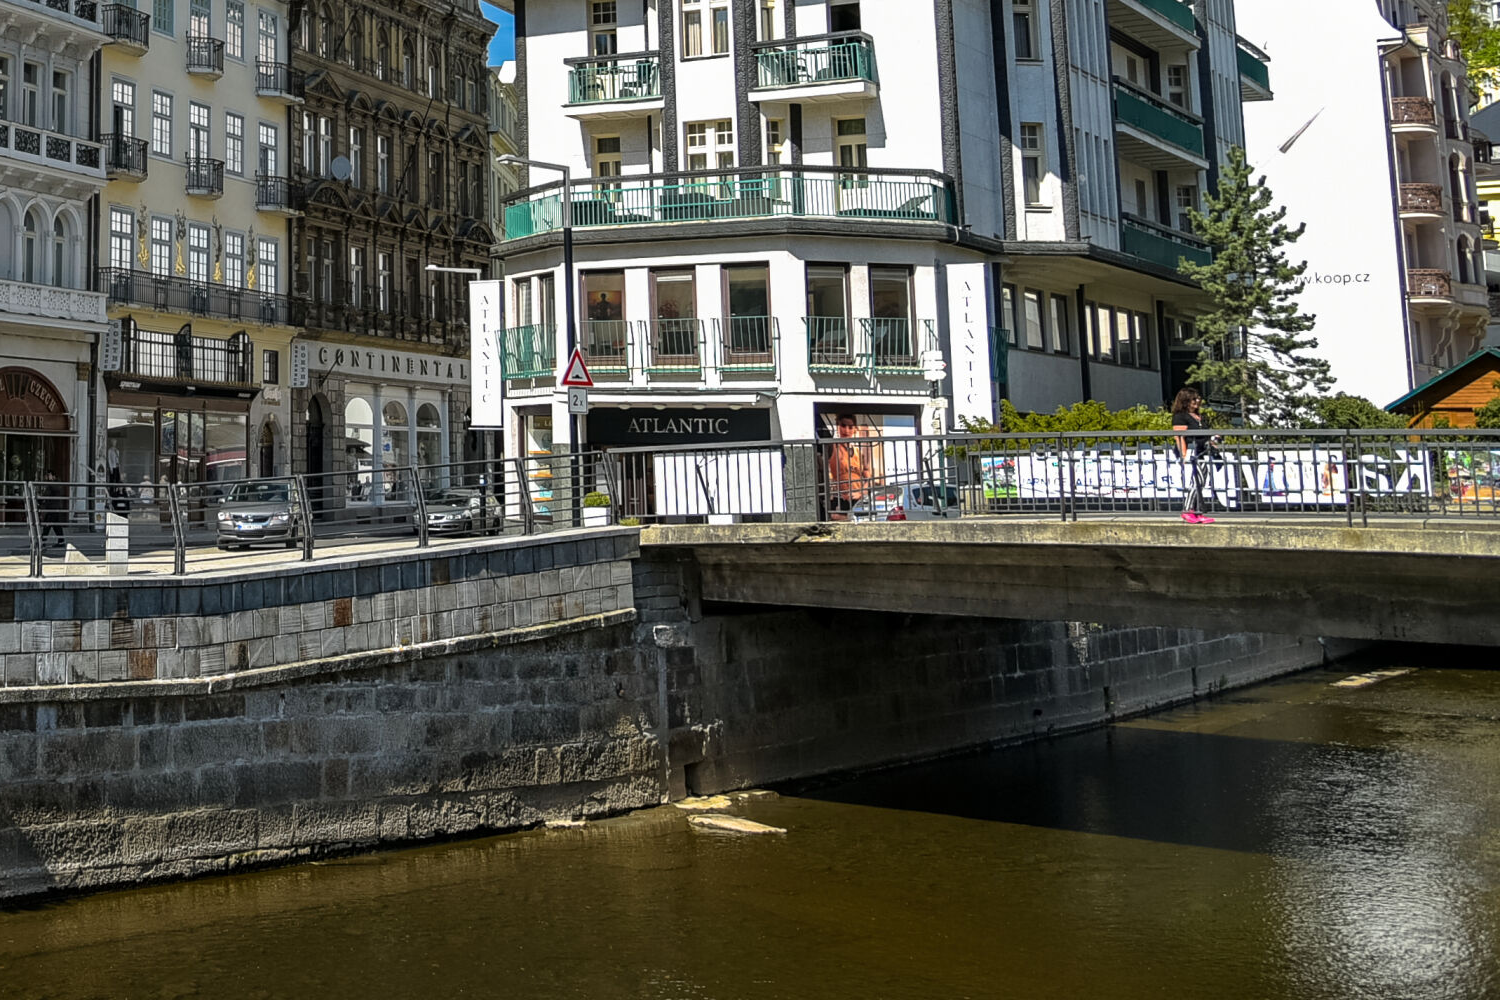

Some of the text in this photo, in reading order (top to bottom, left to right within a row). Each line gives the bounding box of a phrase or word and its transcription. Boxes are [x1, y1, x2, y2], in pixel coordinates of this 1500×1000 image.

[1288, 271, 1371, 287] ww.koop.cz
[480, 294, 491, 404] ATLANTIC
[961, 280, 978, 405] ATLANTIC
[318, 346, 468, 380] CONTINENTAL
[29, 380, 57, 412] CZECH
[627, 416, 730, 436] ATLANTIC
